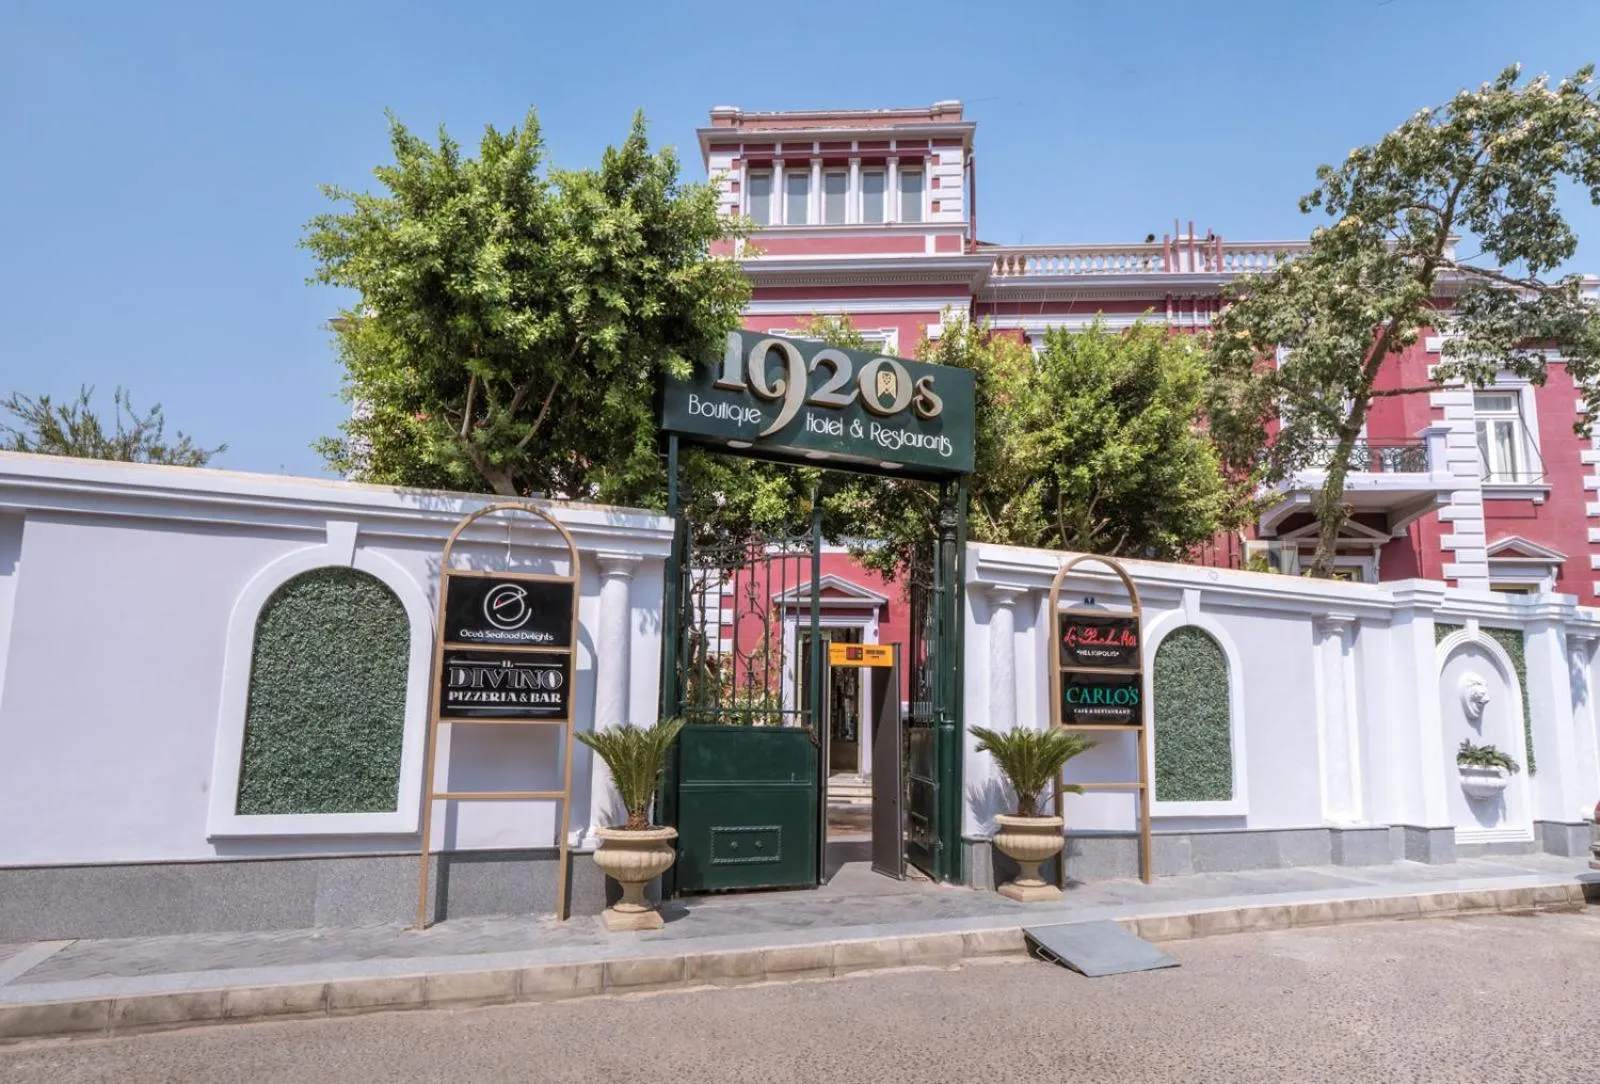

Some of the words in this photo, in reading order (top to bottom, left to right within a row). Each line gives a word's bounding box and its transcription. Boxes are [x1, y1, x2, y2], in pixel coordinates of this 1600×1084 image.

[713, 331, 944, 437] 1920s
[688, 394, 762, 427] Boutique
[806, 412, 844, 436] Hotel
[849, 417, 864, 439] &
[870, 422, 954, 457] Restaurants
[485, 630, 520, 640] Seafood
[521, 631, 554, 642] Delights
[448, 667, 563, 690] DIVINO
[448, 690, 518, 702] PIZZERIA
[519, 693, 528, 703] &
[530, 692, 562, 703] BAR
[1066, 686, 1139, 706] CARLO'S
